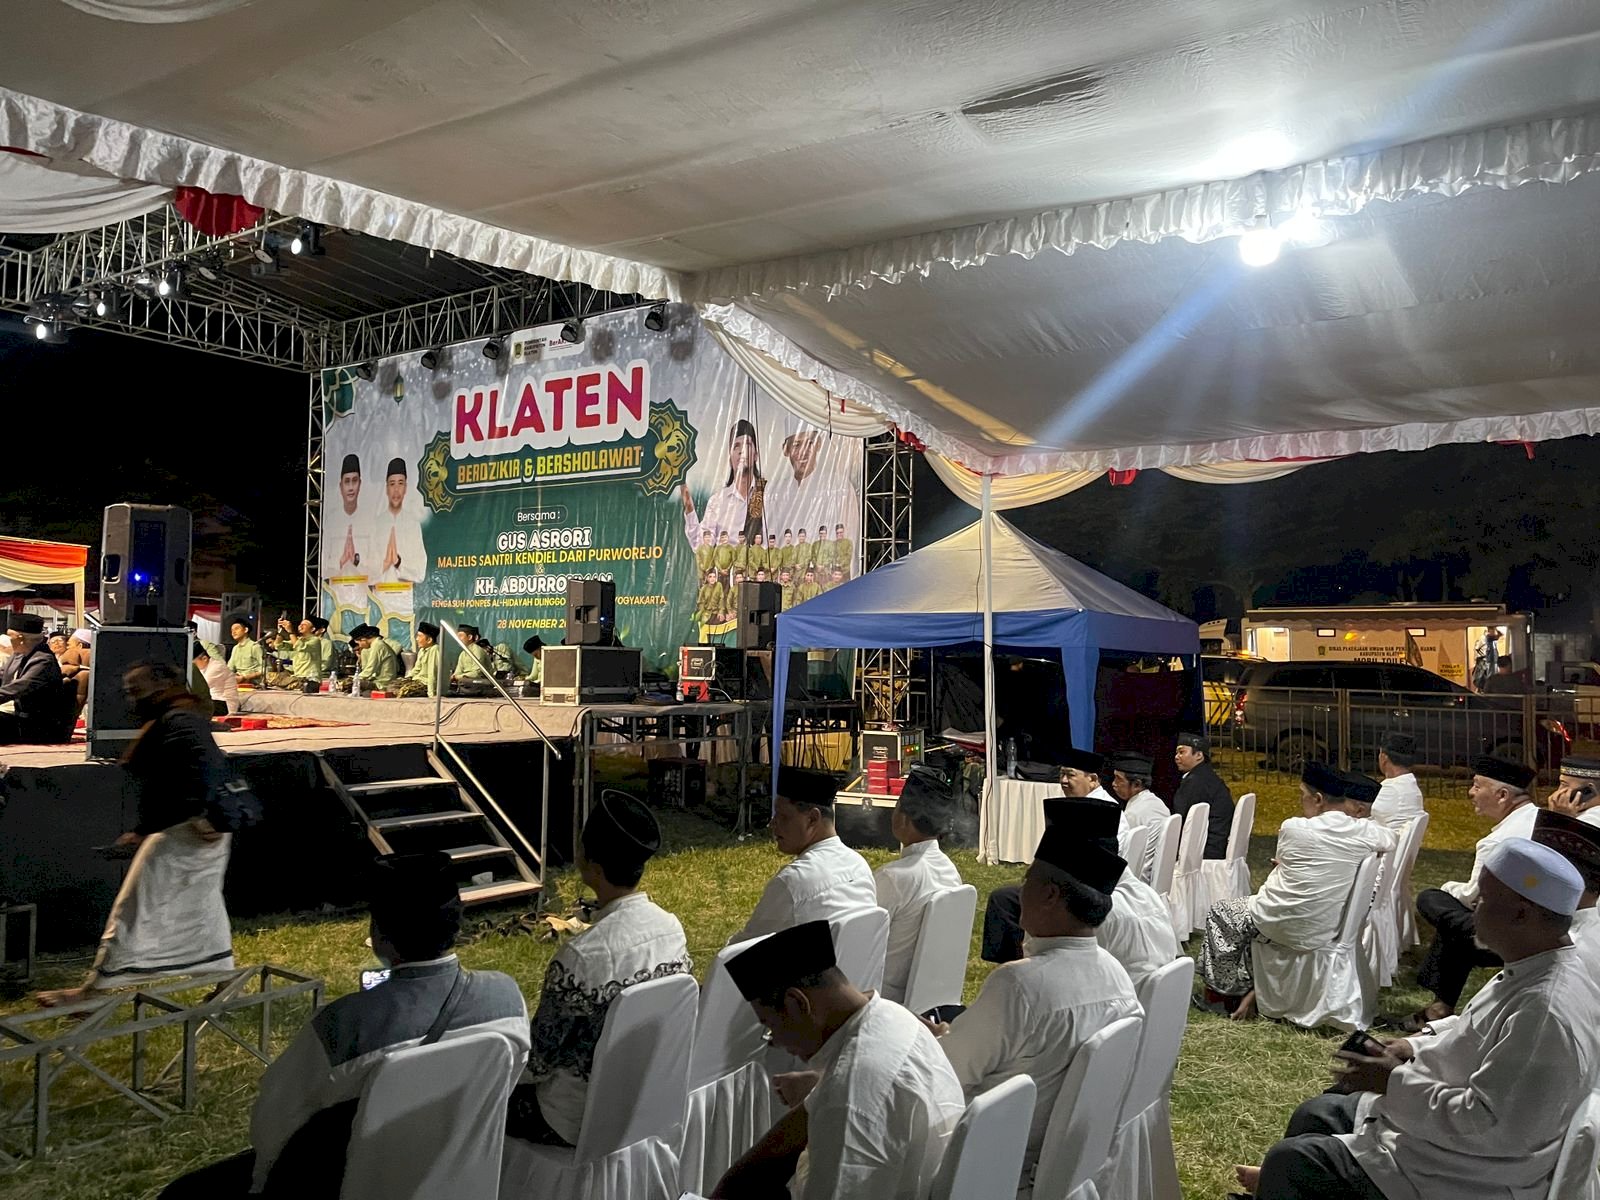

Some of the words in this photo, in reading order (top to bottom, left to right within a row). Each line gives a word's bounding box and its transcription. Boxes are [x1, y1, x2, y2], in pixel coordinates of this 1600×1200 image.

[455, 366, 644, 444] KLATEN
[536, 445, 642, 476] BERSHOLAWAT
[517, 511, 556, 522] Bersama
[498, 531, 527, 551] GUS
[528, 527, 592, 550] ASRORI
[437, 556, 477, 569] MAJELIS
[479, 553, 513, 567] SANTRI
[515, 551, 558, 565] KENDIEL
[559, 549, 586, 563] DARI
[588, 546, 663, 562] PURWOREJO
[474, 577, 499, 595] KH.
[500, 573, 613, 595] ABDURRO
[431, 600, 466, 609] PENGASUH
[466, 599, 491, 608] PONPES
[492, 598, 533, 607] AL-HIDAYAH
[615, 595, 667, 605] YOGYAKARTA
[497, 620, 507, 629] 28
[508, 619, 558, 629] NOVEMBER
